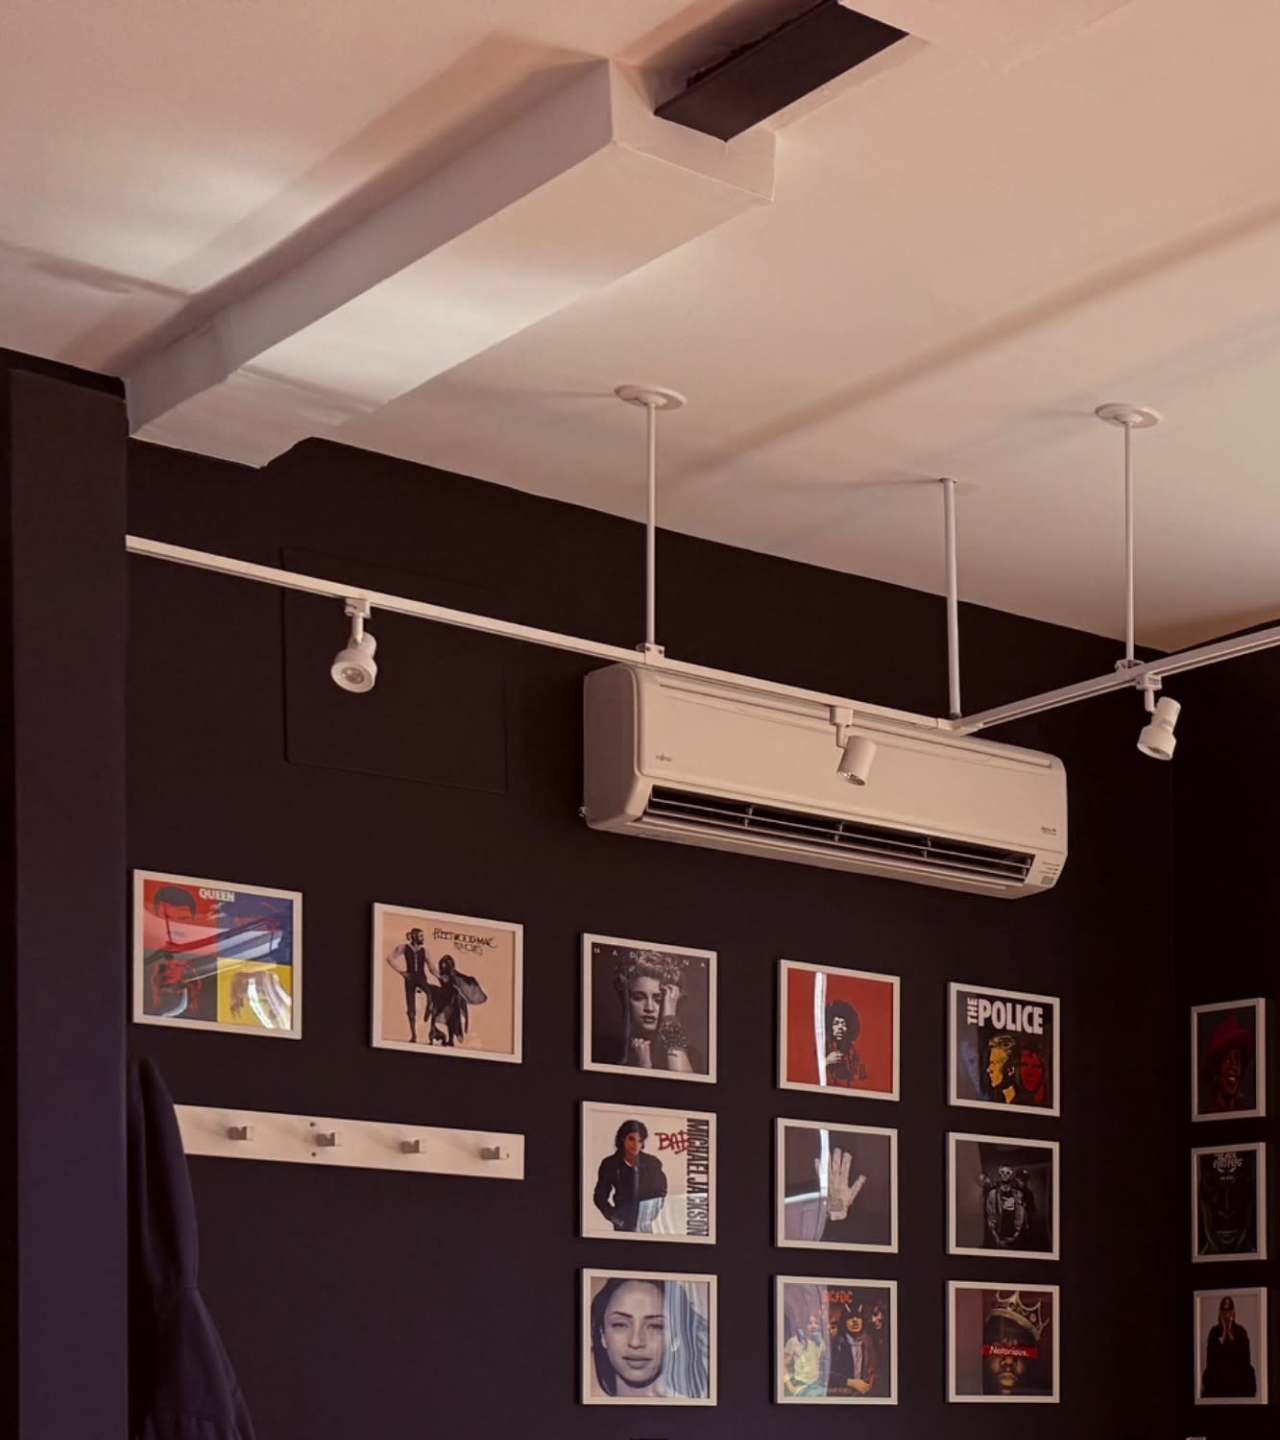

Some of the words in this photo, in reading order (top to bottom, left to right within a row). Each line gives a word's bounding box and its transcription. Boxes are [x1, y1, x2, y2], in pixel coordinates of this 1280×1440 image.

[198, 888, 236, 902] QUEEN
[967, 996, 978, 1025] THE
[978, 998, 1044, 1035] POLICE
